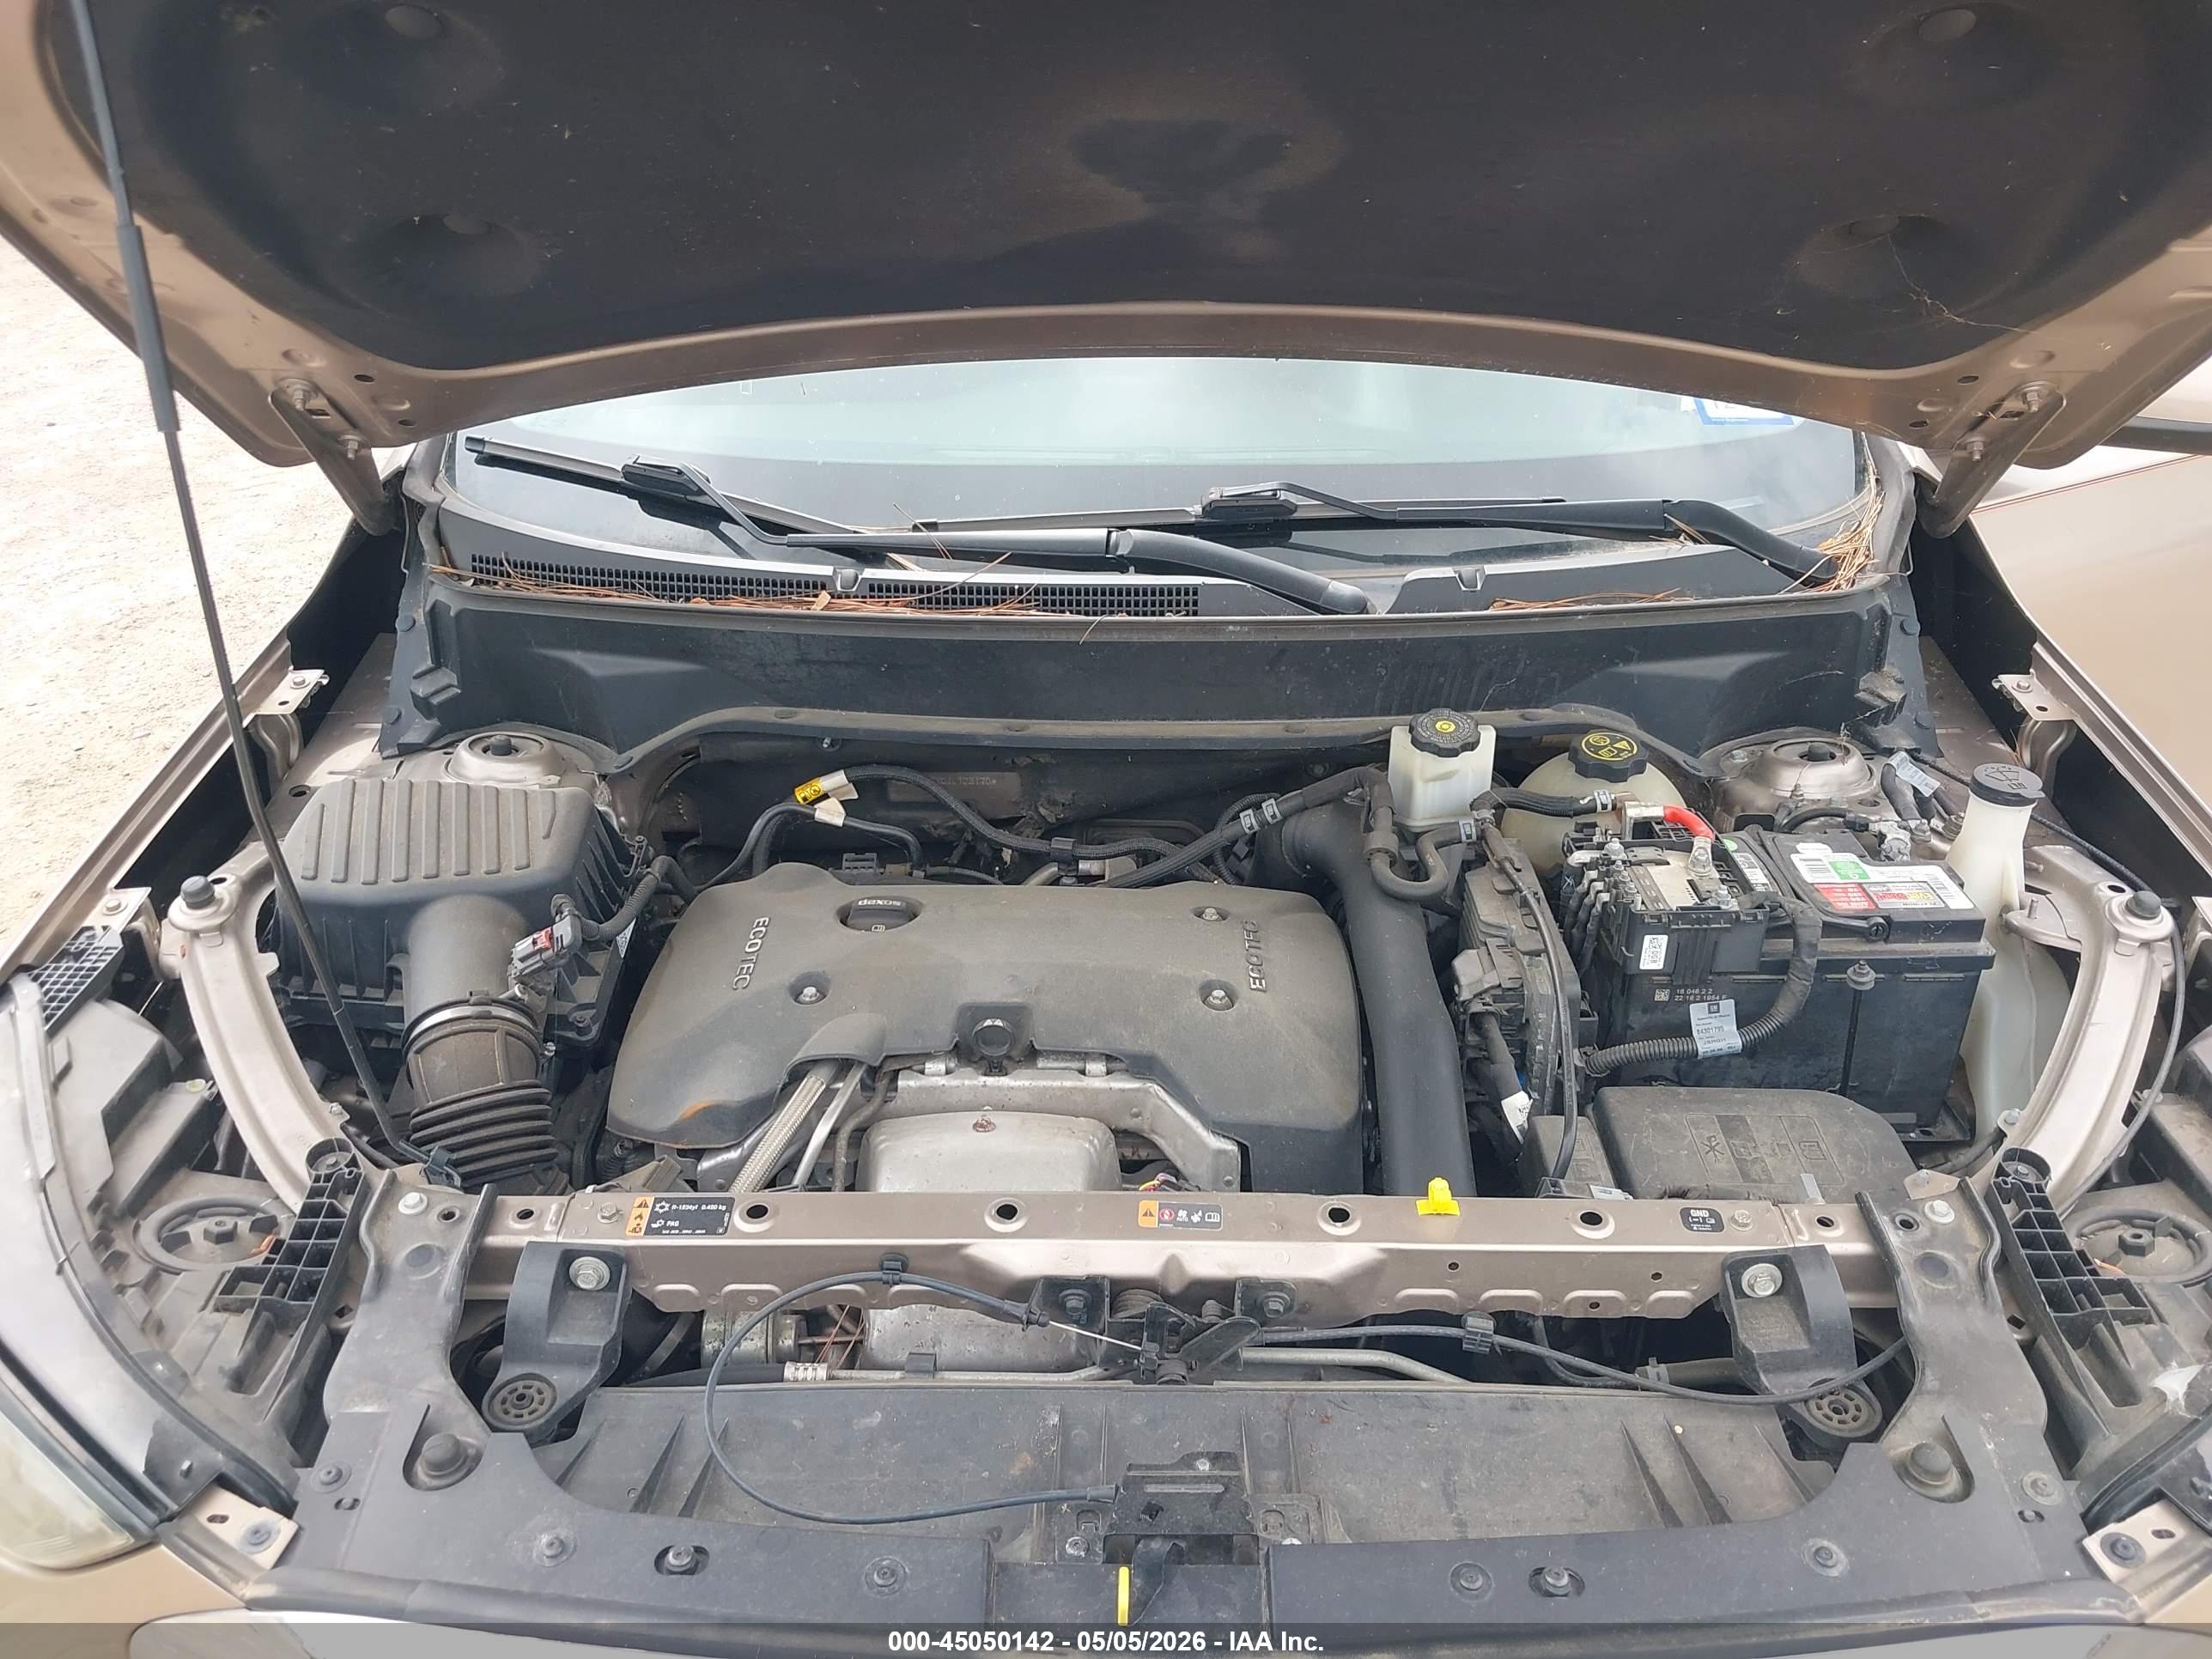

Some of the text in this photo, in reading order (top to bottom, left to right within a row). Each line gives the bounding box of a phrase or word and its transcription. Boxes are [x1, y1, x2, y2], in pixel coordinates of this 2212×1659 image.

[858, 898, 902, 907] dexos
[732, 916, 770, 990] ECOTEC
[1243, 920, 1267, 993] ECOTEC
[1690, 1209, 1710, 1218] GND
